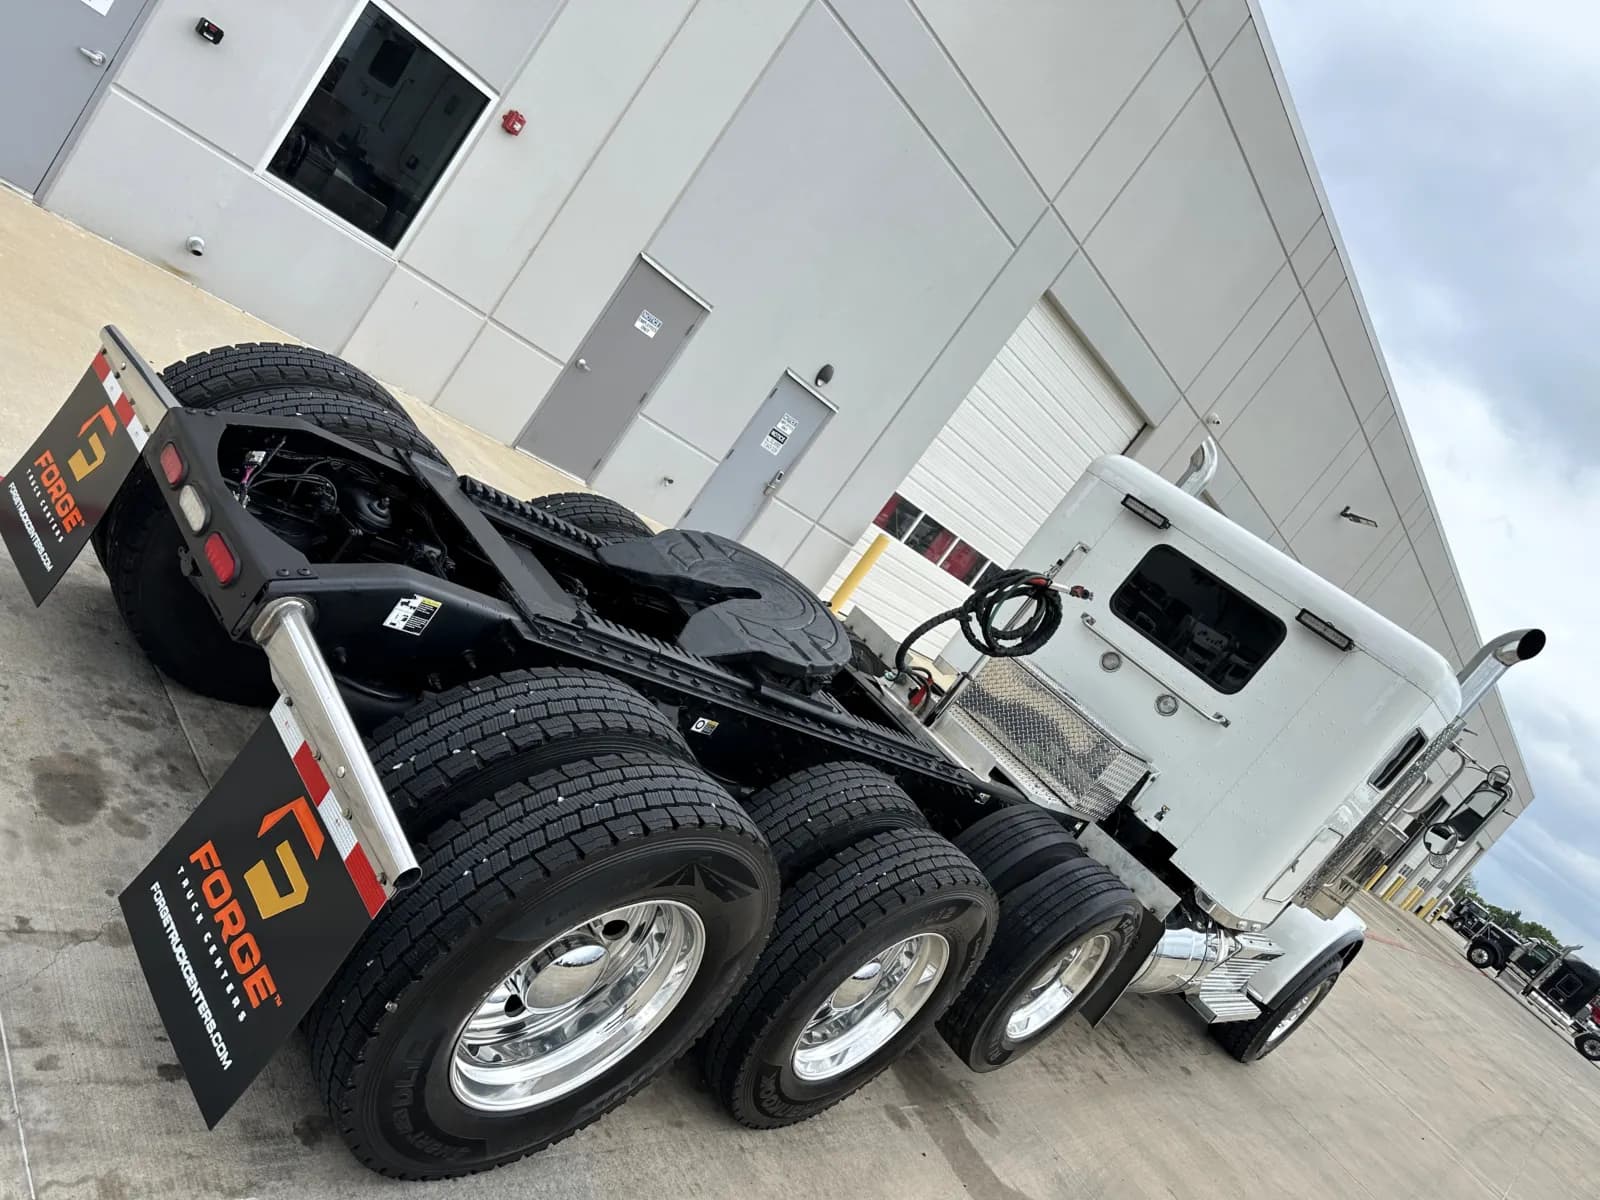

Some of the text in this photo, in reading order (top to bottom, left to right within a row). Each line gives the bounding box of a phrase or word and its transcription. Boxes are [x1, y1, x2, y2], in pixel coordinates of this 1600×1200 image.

[8, 482, 54, 573] FORGETRUCKCENTERS.COM
[26, 468, 64, 543] TRUCK CENTERS
[33, 450, 83, 534] FORGE
[150, 881, 233, 1071] FORGETRUCKCENTERS.COM
[177, 865, 248, 1023] TRUCK CENTERS
[189, 840, 277, 1009] FORGE
